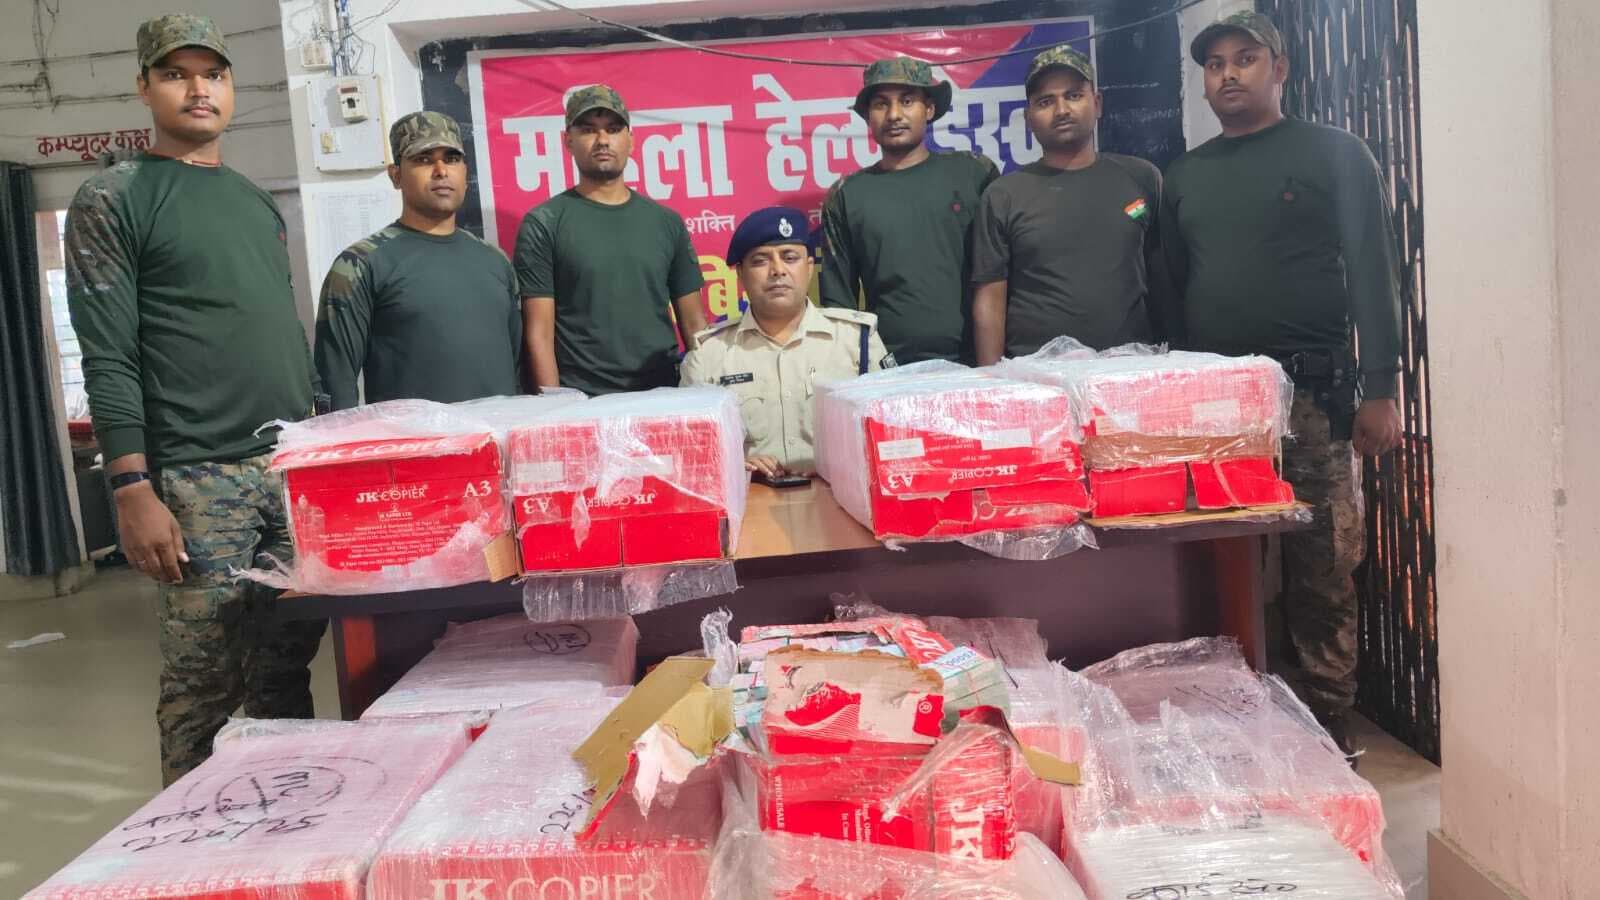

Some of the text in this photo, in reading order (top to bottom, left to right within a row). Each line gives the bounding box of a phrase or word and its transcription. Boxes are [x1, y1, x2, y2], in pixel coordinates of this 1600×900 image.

[502, 85, 734, 199] मिला
[686, 209, 735, 233] शक्ति
[887, 471, 914, 489] A3
[951, 465, 1018, 479] JK COPIER
[356, 487, 426, 503] JK COPIER
[463, 480, 492, 498] A3
[632, 491, 656, 504] JK
[523, 496, 552, 514] A3
[773, 775, 785, 829] WHOLESALE
[950, 799, 986, 862] JK
[429, 874, 657, 900] JK COPIER
